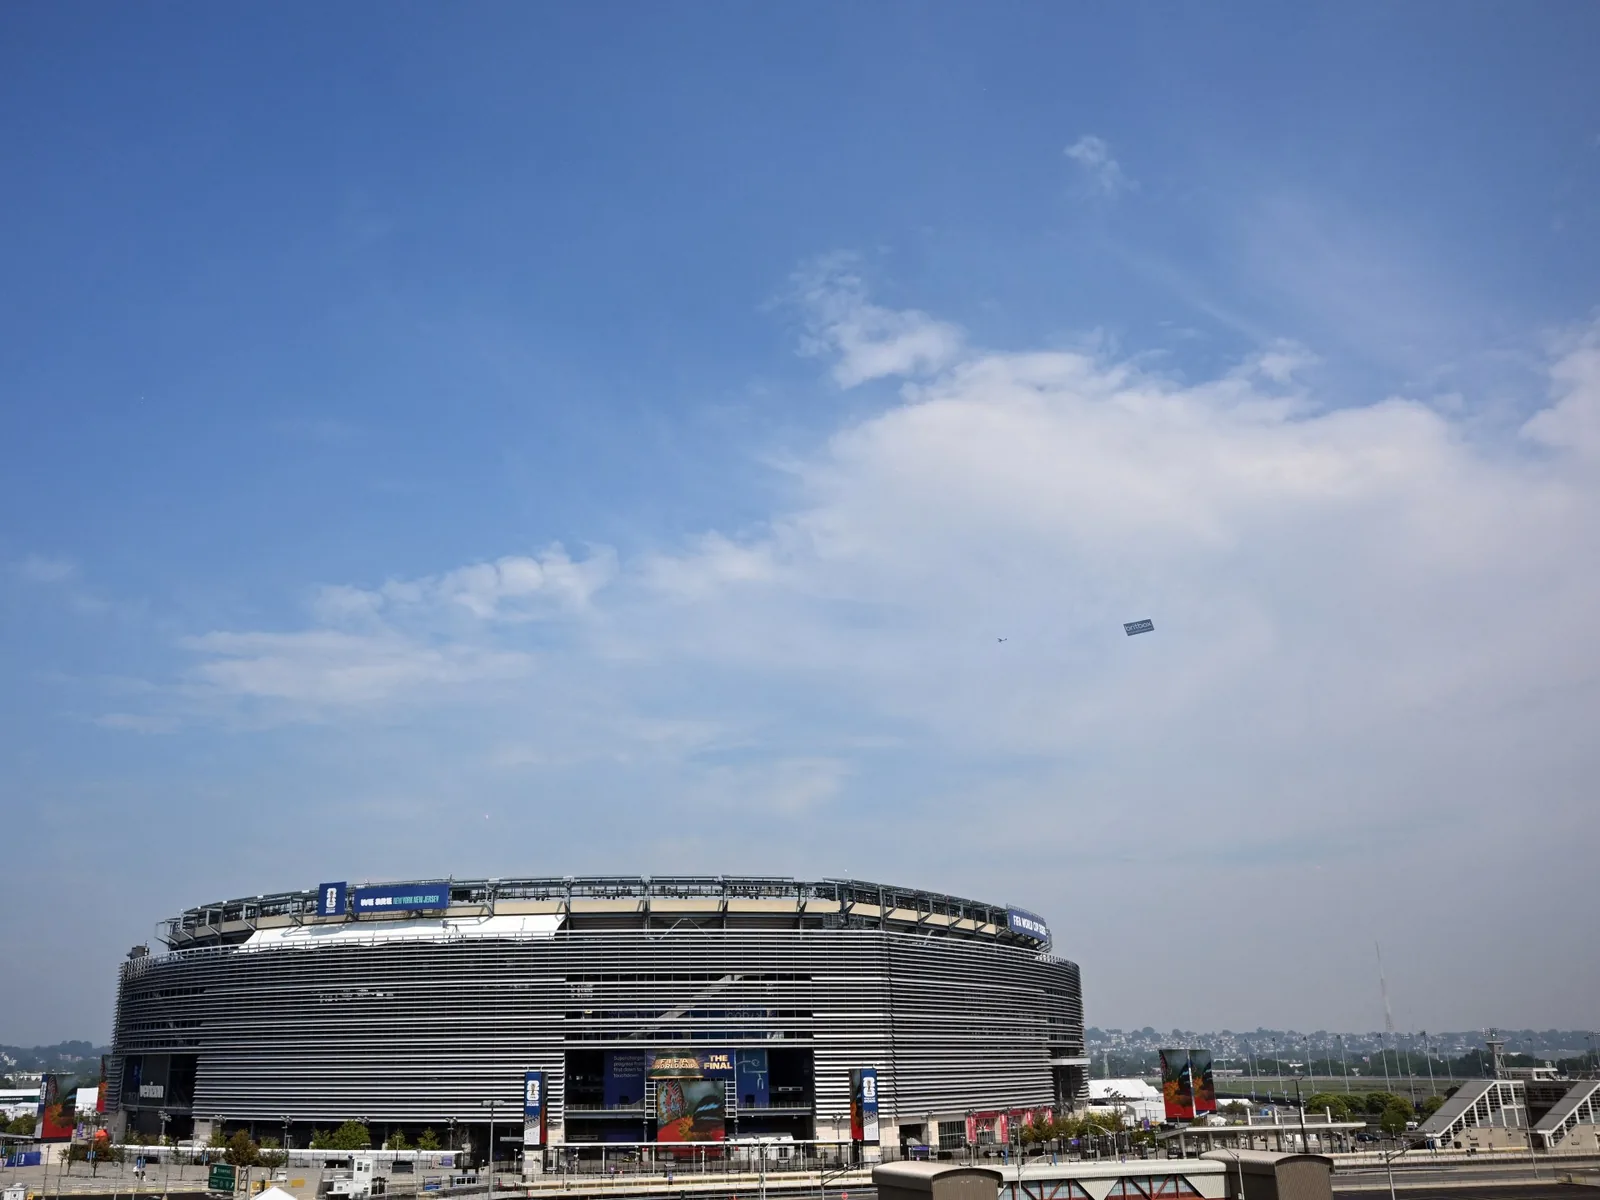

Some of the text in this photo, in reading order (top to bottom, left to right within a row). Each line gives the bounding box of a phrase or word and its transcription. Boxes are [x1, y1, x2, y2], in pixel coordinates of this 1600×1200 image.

[1124, 622, 1151, 632] britbox
[1013, 914, 1022, 926] FIFA
[1022, 917, 1033, 930] WORLD
[140, 1082, 164, 1098] verizon
